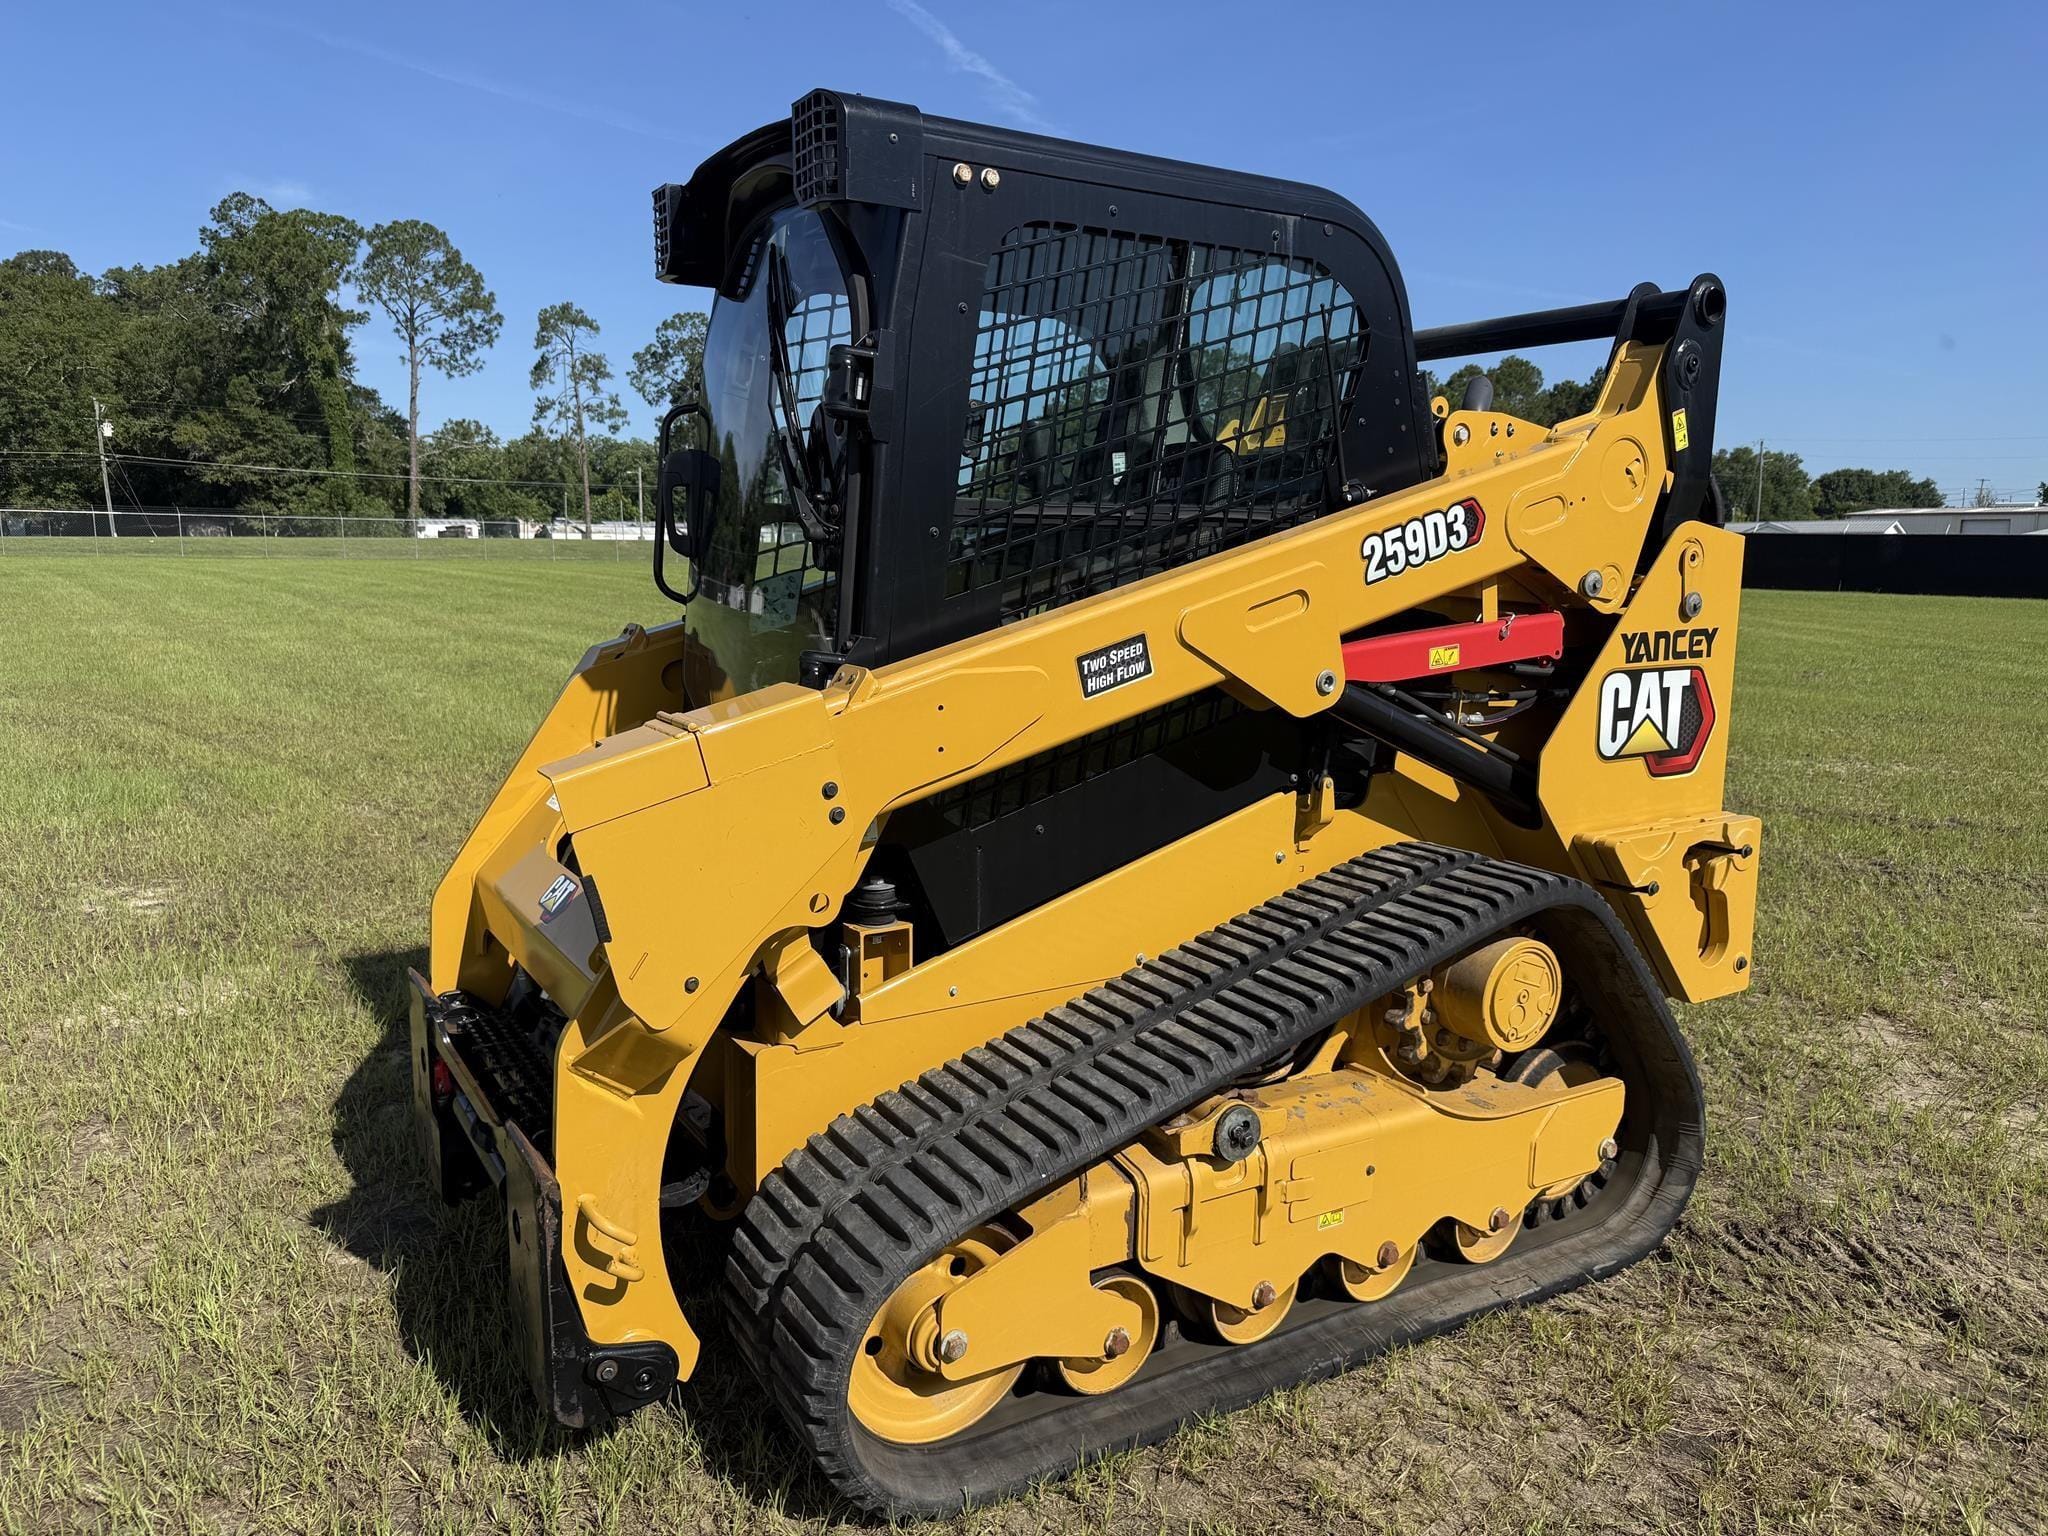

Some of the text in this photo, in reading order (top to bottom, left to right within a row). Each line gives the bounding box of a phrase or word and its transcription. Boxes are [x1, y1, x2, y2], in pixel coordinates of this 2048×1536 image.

[1362, 504, 1468, 583] 259D3
[1082, 642, 1143, 675] TWO SPEED
[1620, 627, 1719, 664] YANCEY
[1087, 660, 1145, 693] HIGH FLOW
[1599, 669, 1691, 757] CAT
[540, 874, 577, 913] CAT
